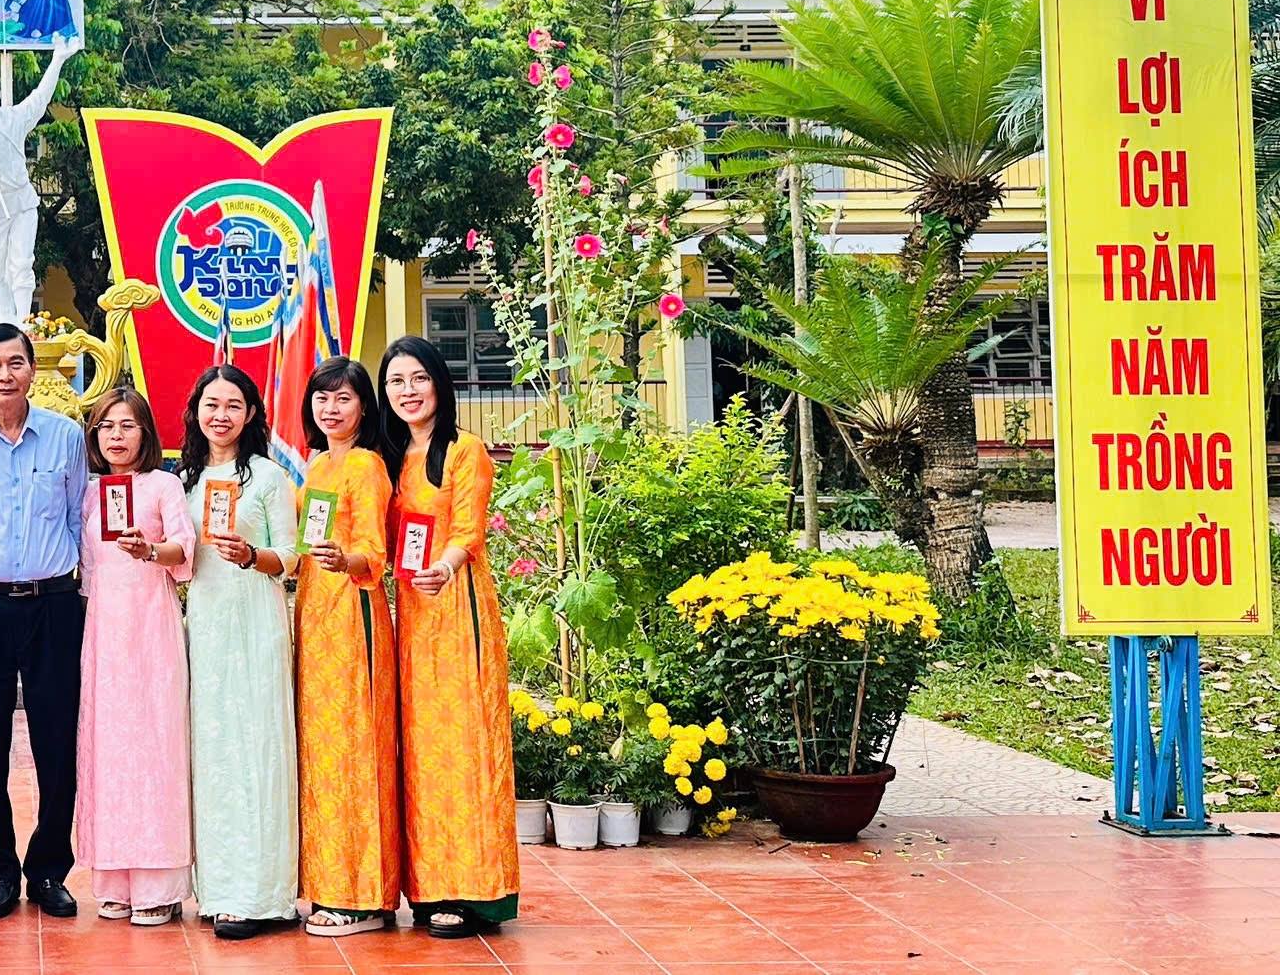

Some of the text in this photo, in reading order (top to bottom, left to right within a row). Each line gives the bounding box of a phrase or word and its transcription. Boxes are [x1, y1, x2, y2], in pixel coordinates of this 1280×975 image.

[1117, 51, 1183, 128] LỢI
[1119, 137, 1190, 209] ÍCH
[257, 204, 281, 224] TRUNG
[1095, 230, 1217, 302] TRĂM
[245, 313, 265, 326] HỘI
[1110, 324, 1210, 397] NĂM
[1091, 411, 1234, 491] TRỒNG
[1100, 512, 1233, 588] NGƯỜI
